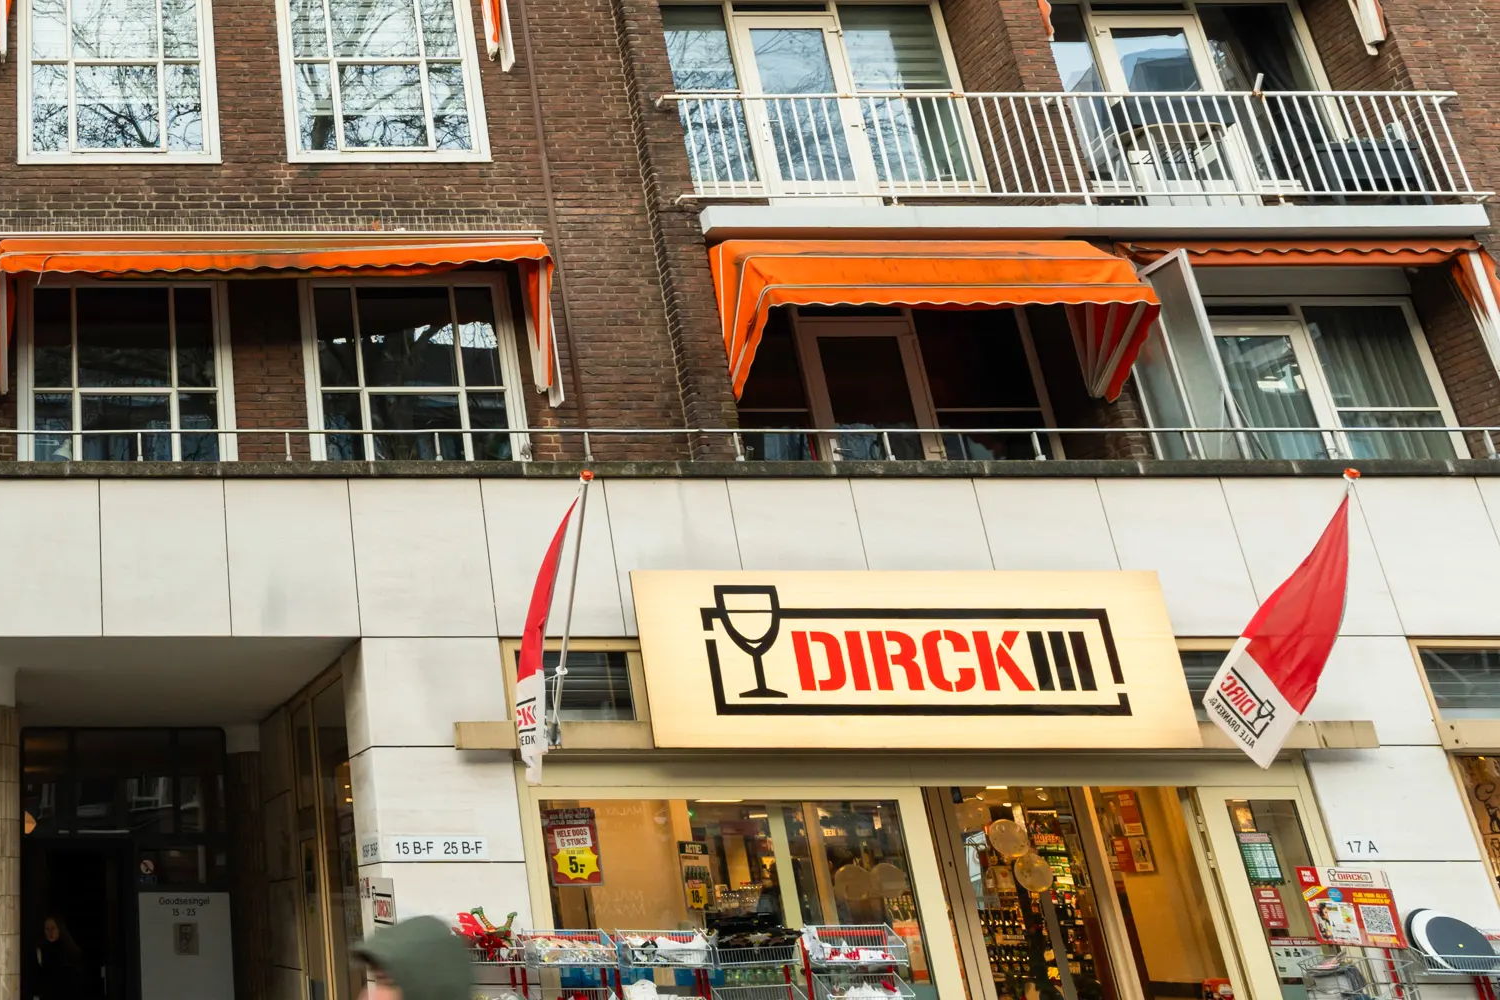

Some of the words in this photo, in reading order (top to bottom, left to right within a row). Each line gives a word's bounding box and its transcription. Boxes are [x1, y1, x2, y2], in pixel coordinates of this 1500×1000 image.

[395, 841, 410, 855] 15
[413, 841, 434, 855] B-F
[443, 841, 459, 855] 25
[461, 841, 483, 855] B-F
[1346, 840, 1362, 853] 17
[1368, 840, 1379, 853] A
